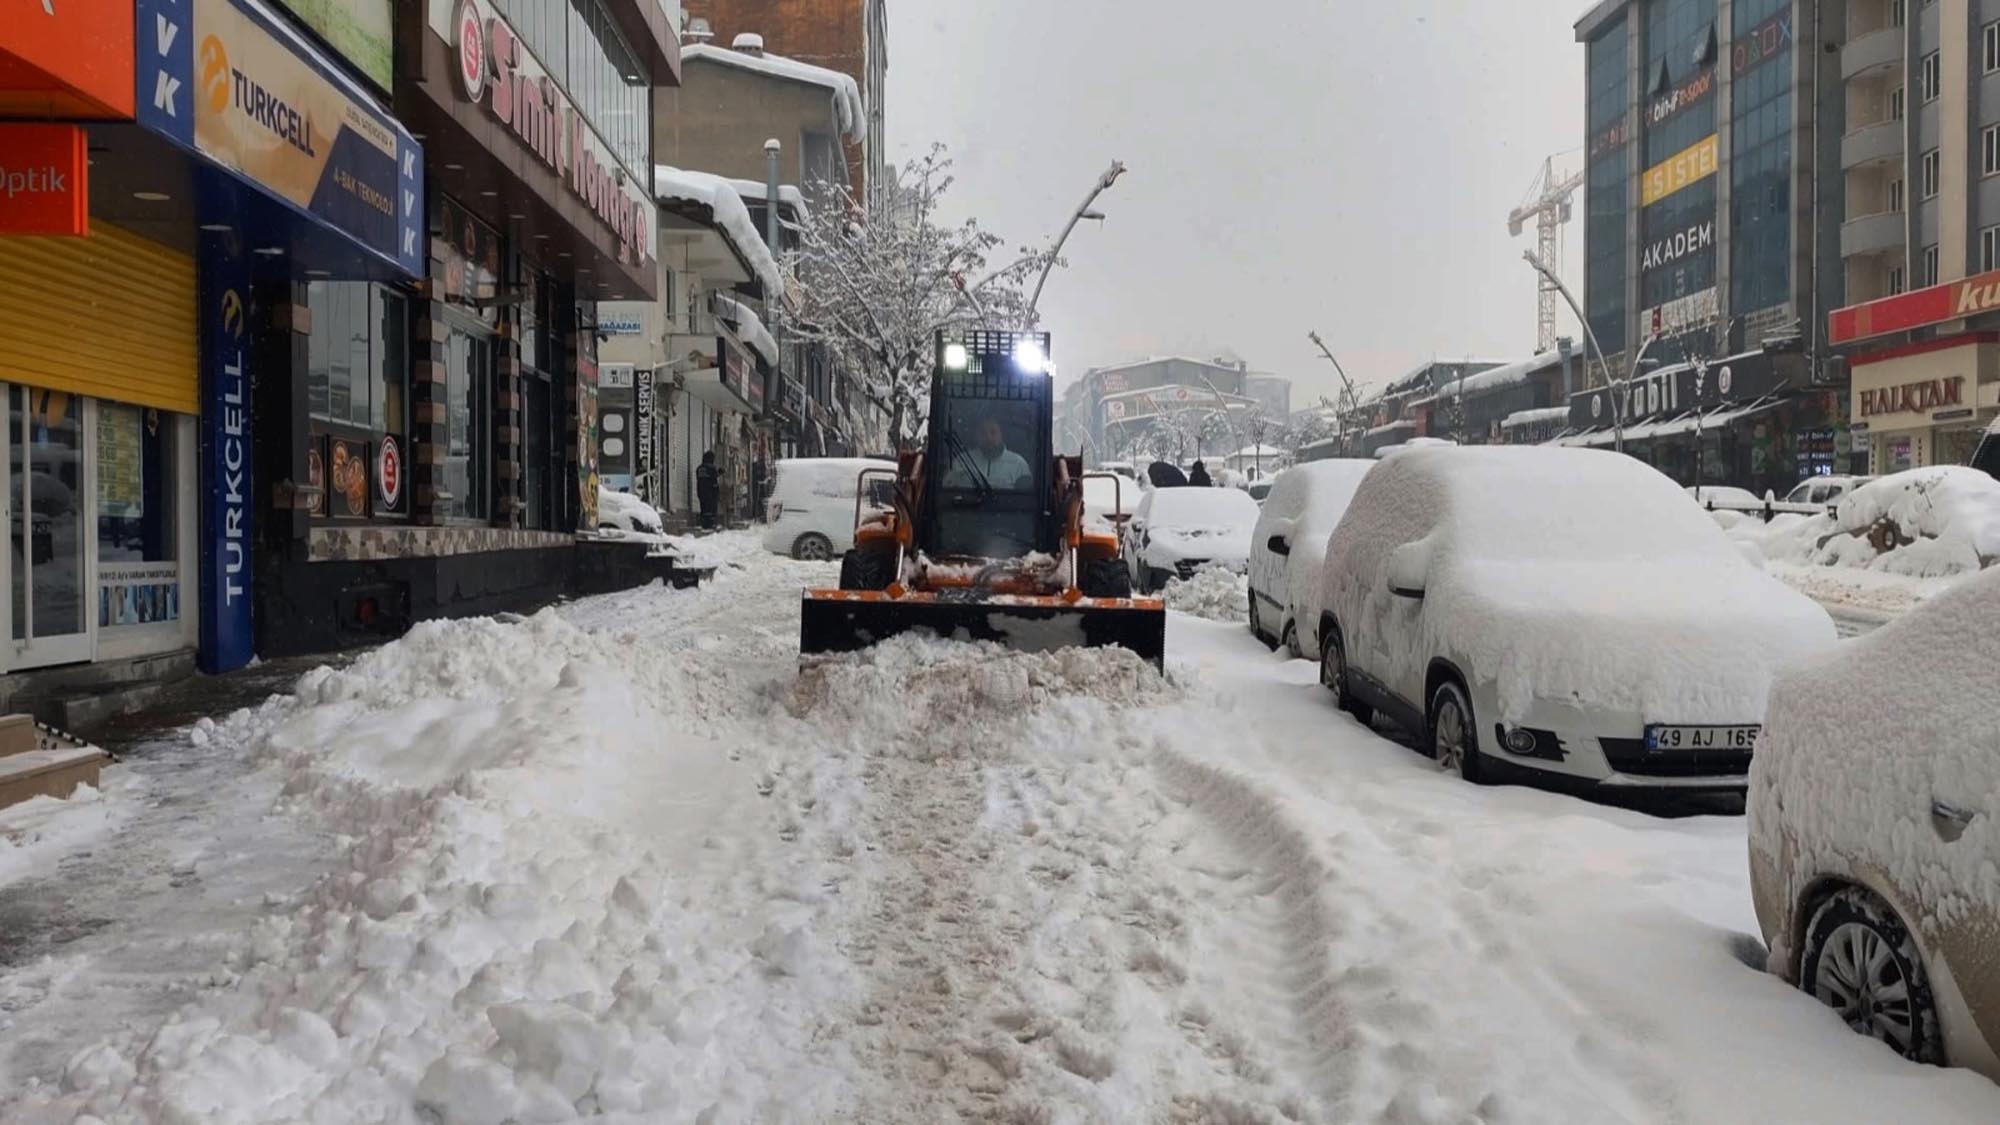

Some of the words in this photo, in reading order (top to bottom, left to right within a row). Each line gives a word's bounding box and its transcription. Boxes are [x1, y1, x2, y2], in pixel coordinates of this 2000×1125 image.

[154, 0, 181, 117] VK
[232, 67, 315, 158] TURKCELL
[491, 18, 565, 179] Simit
[403, 149, 417, 257] KVK
[1860, 376, 1966, 417] HALKTAN
[225, 350, 243, 606] TURKCELL
[1659, 729, 1681, 746] 49
[1692, 729, 1714, 746] AJ
[1727, 728, 1758, 746] 165
